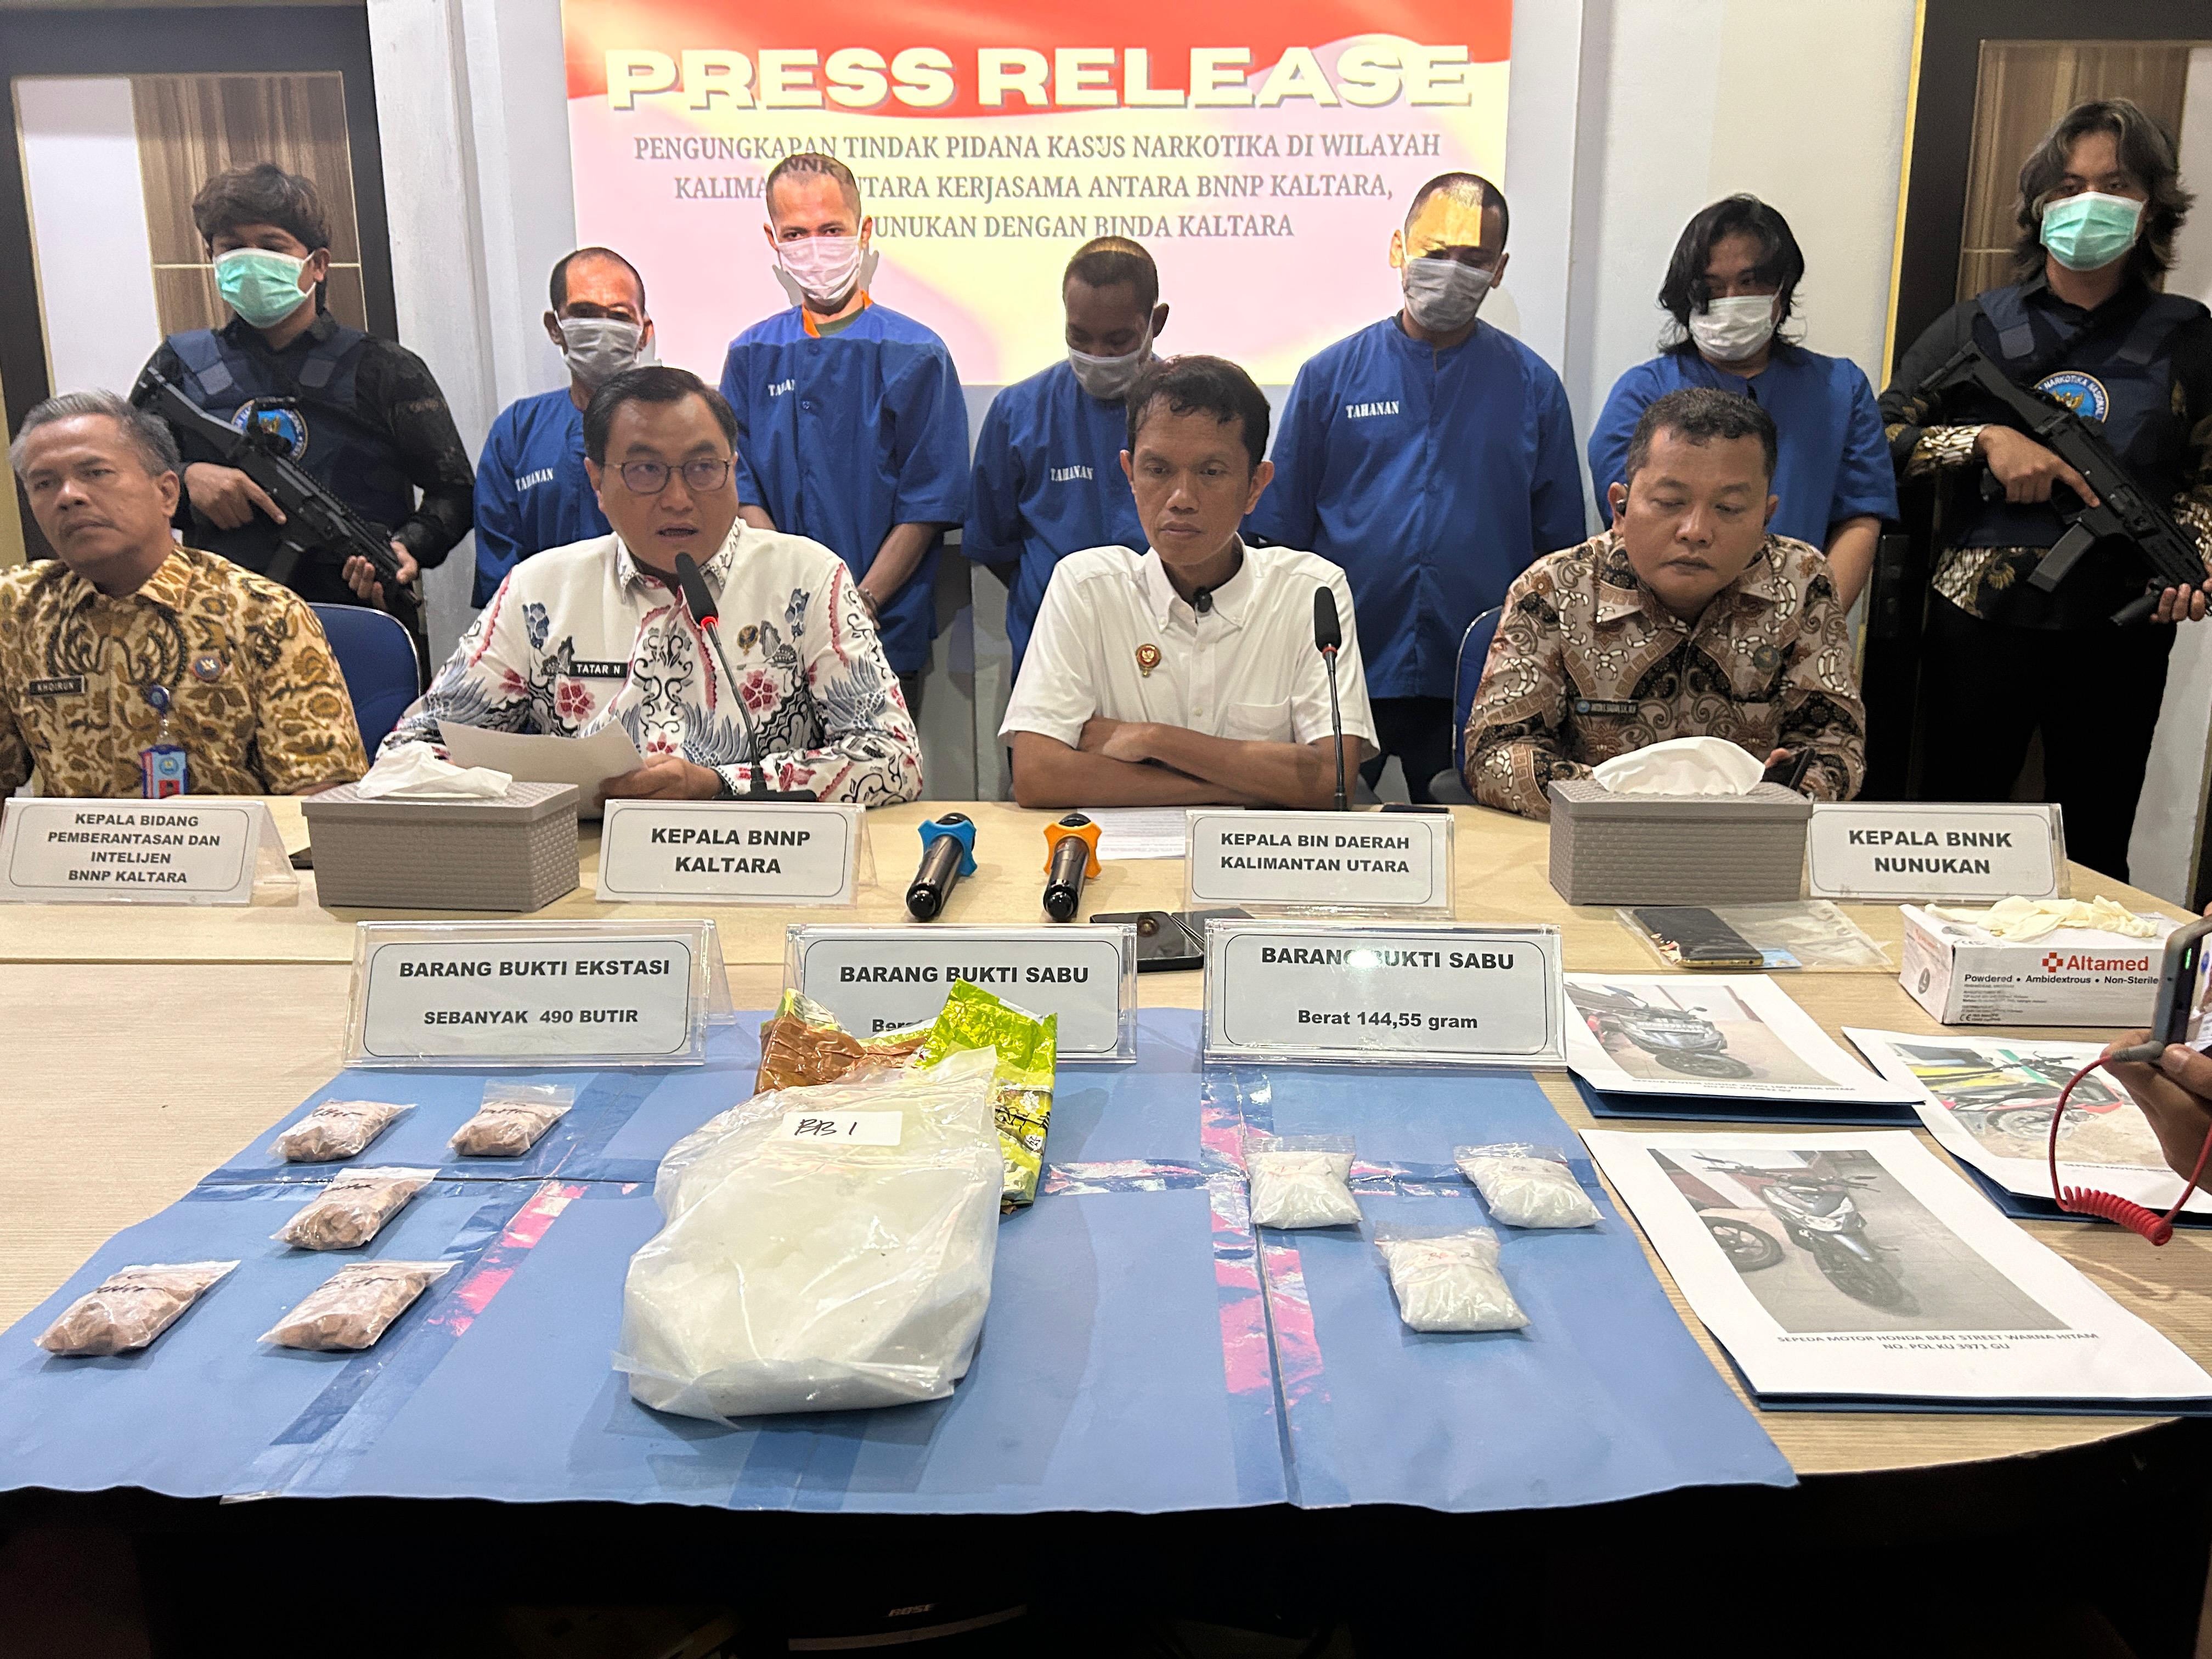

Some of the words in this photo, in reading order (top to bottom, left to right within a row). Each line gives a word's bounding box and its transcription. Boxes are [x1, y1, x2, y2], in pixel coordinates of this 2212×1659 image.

[605, 47, 957, 111] PRESS
[977, 44, 1474, 110] RELEASE
[634, 136, 837, 160] PENGUNGKAPAN
[844, 136, 940, 159] TINDAK
[946, 135, 1039, 158] PIDANA
[1047, 135, 1126, 158] KASUS
[1133, 134, 1279, 157] NARKOTIKA
[1287, 134, 1313, 157] DI
[1322, 133, 1441, 156] WILAYAH
[936, 176, 1082, 203] KERJASAMA
[1088, 176, 1190, 198] ANTARA
[1198, 175, 1264, 198] BNNP
[1269, 174, 1393, 200] KALTARA,
[873, 216, 978, 238] UNUKAN
[985, 216, 1086, 238] DENGAN
[1095, 215, 1170, 237] BINDA
[1178, 215, 1294, 236] KALTARA
[1345, 400, 1400, 419] TAHANAN
[577, 664, 608, 674] TATAR
[613, 665, 620, 674] N
[75, 813, 136, 826] KEPALA
[140, 815, 199, 827] BIDANG
[47, 831, 184, 845] PEMBERANTASAN
[188, 835, 220, 846] DAN
[651, 828, 740, 845] KEPALA
[748, 830, 810, 847] BNNP
[1221, 833, 1292, 847] KEPALA
[1297, 835, 1329, 847] BIN
[1335, 836, 1409, 849] DAERAH
[1849, 830, 1939, 846] KEPALA
[1946, 832, 2012, 848] BNNK
[91, 851, 171, 864] INTELIJEN
[675, 856, 781, 874] KALTARA
[1221, 856, 1340, 871] KALIMANTAN
[1347, 859, 1409, 873] UTARA
[1874, 857, 1990, 874] NUNUKAN
[68, 870, 111, 881] BNNP
[115, 871, 187, 883] KALTARA
[399, 962, 492, 977] BARANG
[499, 961, 567, 976] BUKTI
[575, 960, 669, 975] EKSTASI
[1449, 952, 1514, 970] SABU
[2067, 955, 2149, 971] Altamed
[840, 966, 938, 983] BARANG
[946, 967, 1017, 983] BUKTI
[1025, 967, 1088, 983] SABU
[1965, 974, 2013, 983] Powdered
[2025, 975, 2091, 984] Ambidextrous
[2104, 976, 2159, 984] Non-Sterile
[424, 1011, 528, 1025] SEBANYAK
[539, 1010, 573, 1024] 490
[579, 1009, 638, 1023] BUTIR
[1298, 1009, 1350, 1025] Berat
[1357, 1011, 1421, 1029] 144,55
[1428, 1017, 1477, 1031] gram
